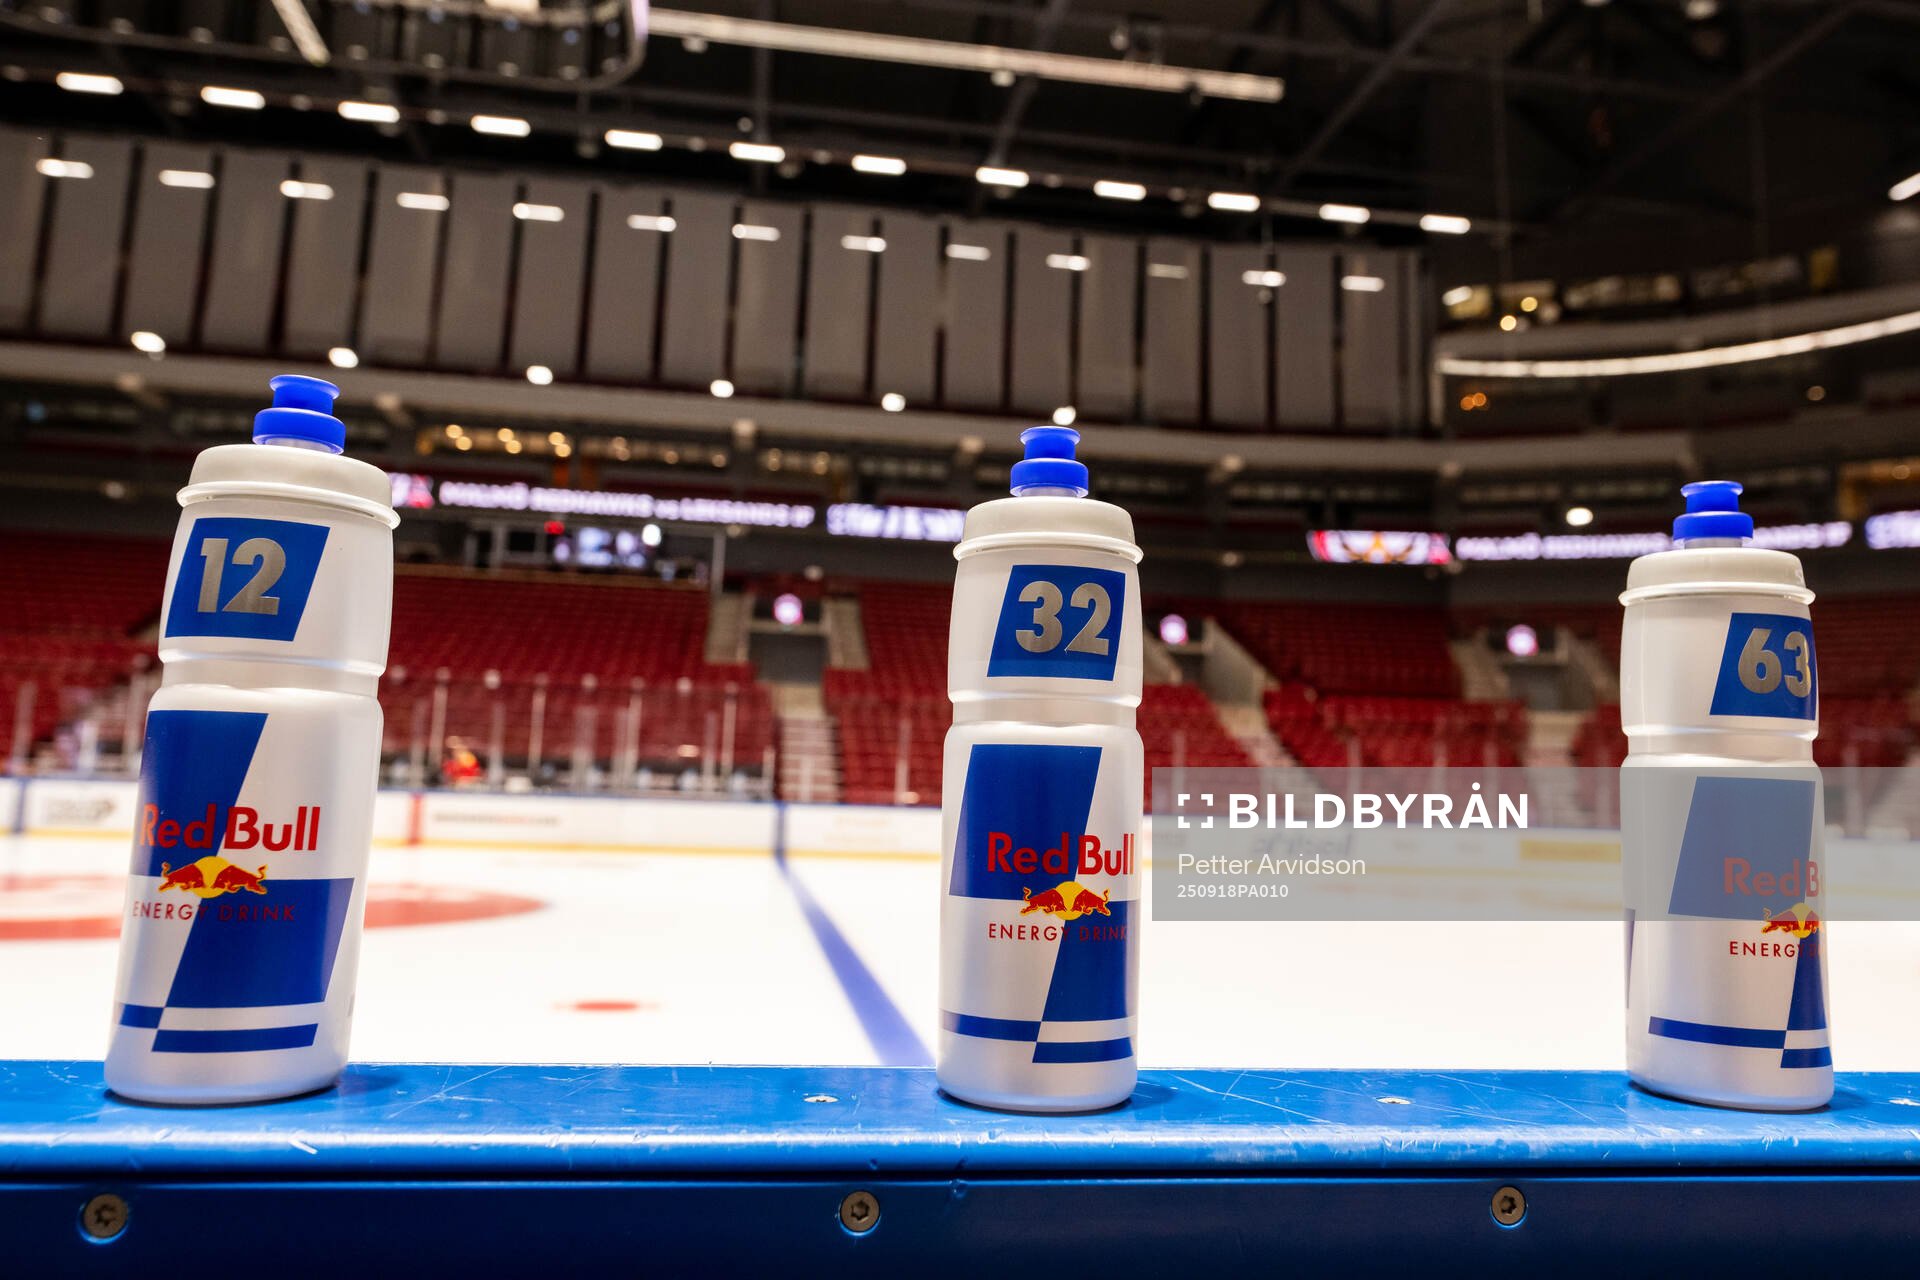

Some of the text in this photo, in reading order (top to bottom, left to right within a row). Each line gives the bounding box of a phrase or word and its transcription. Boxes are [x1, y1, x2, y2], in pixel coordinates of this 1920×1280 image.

[197, 537, 286, 616] 12
[1015, 580, 1112, 656] 32
[1737, 627, 1812, 698] 63
[140, 803, 217, 850] Red
[223, 806, 321, 852] Bull
[986, 831, 1135, 877] Red Bull
[1723, 857, 1801, 897] Red
[132, 900, 297, 922] ENERGY DRINK
[988, 922, 1070, 942] ENERGY
[1729, 940, 1804, 958] ENERGY
